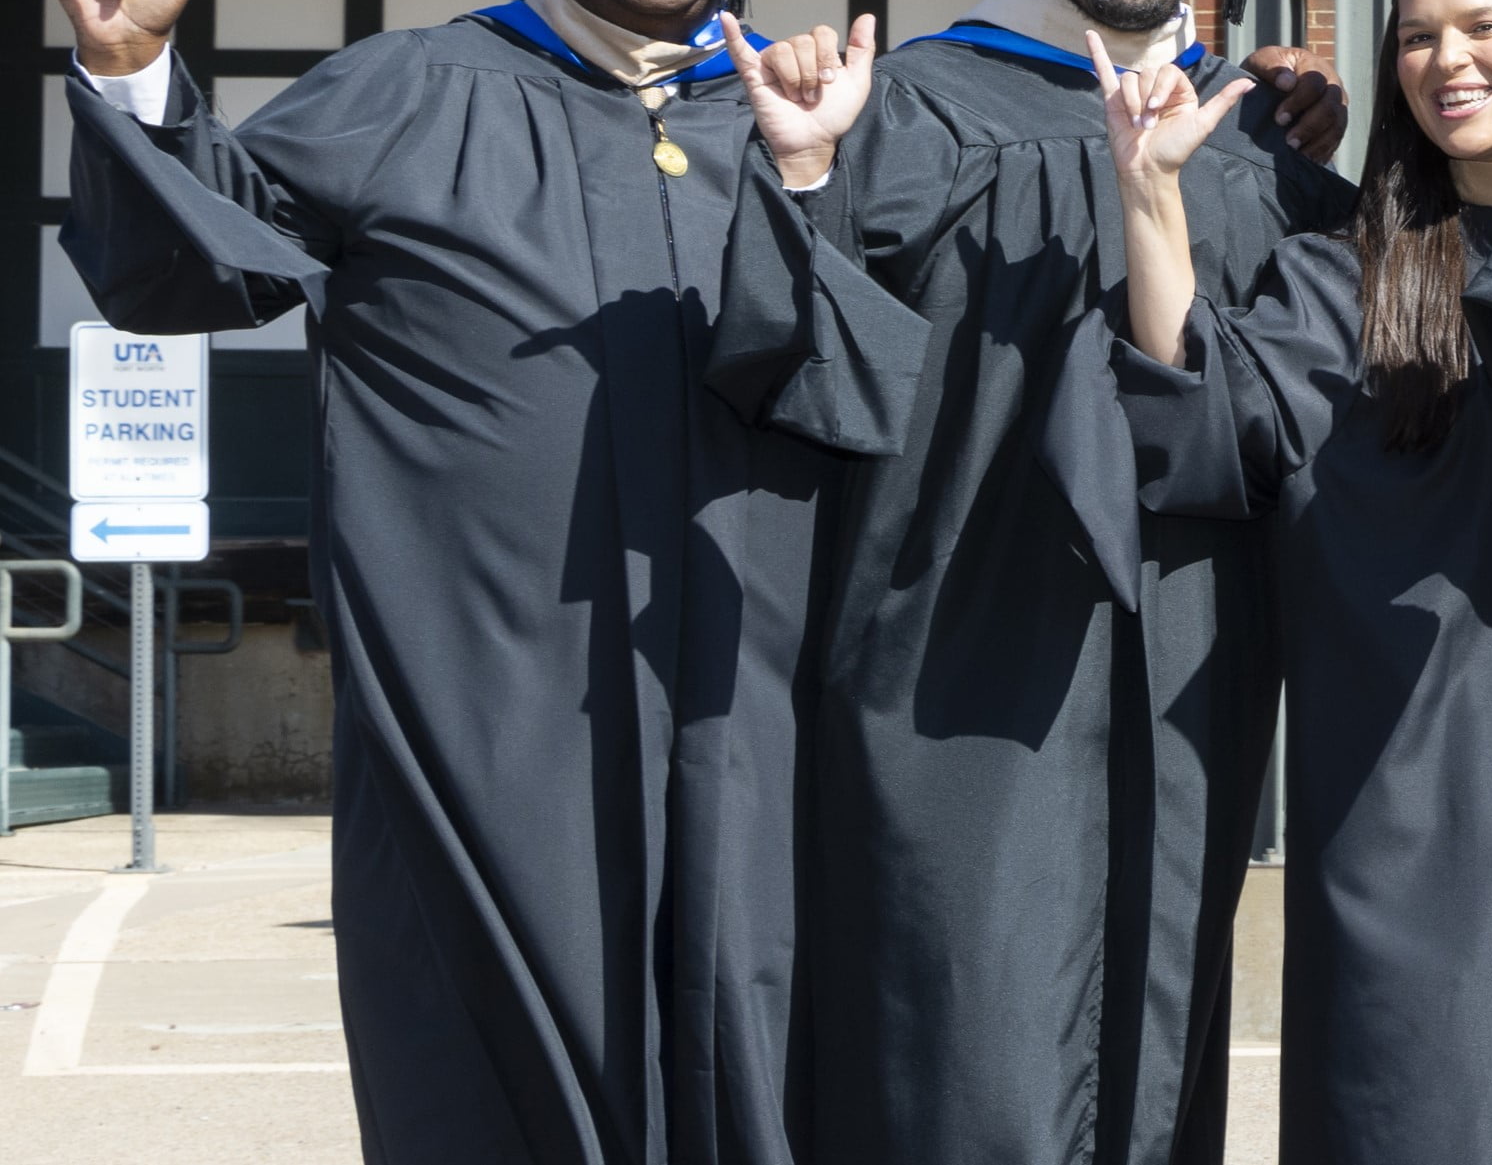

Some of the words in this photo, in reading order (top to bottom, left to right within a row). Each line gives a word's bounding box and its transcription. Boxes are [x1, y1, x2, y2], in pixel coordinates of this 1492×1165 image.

[114, 343, 163, 362] UTA
[82, 389, 196, 408] STUDENT
[85, 423, 195, 441] PARKING
